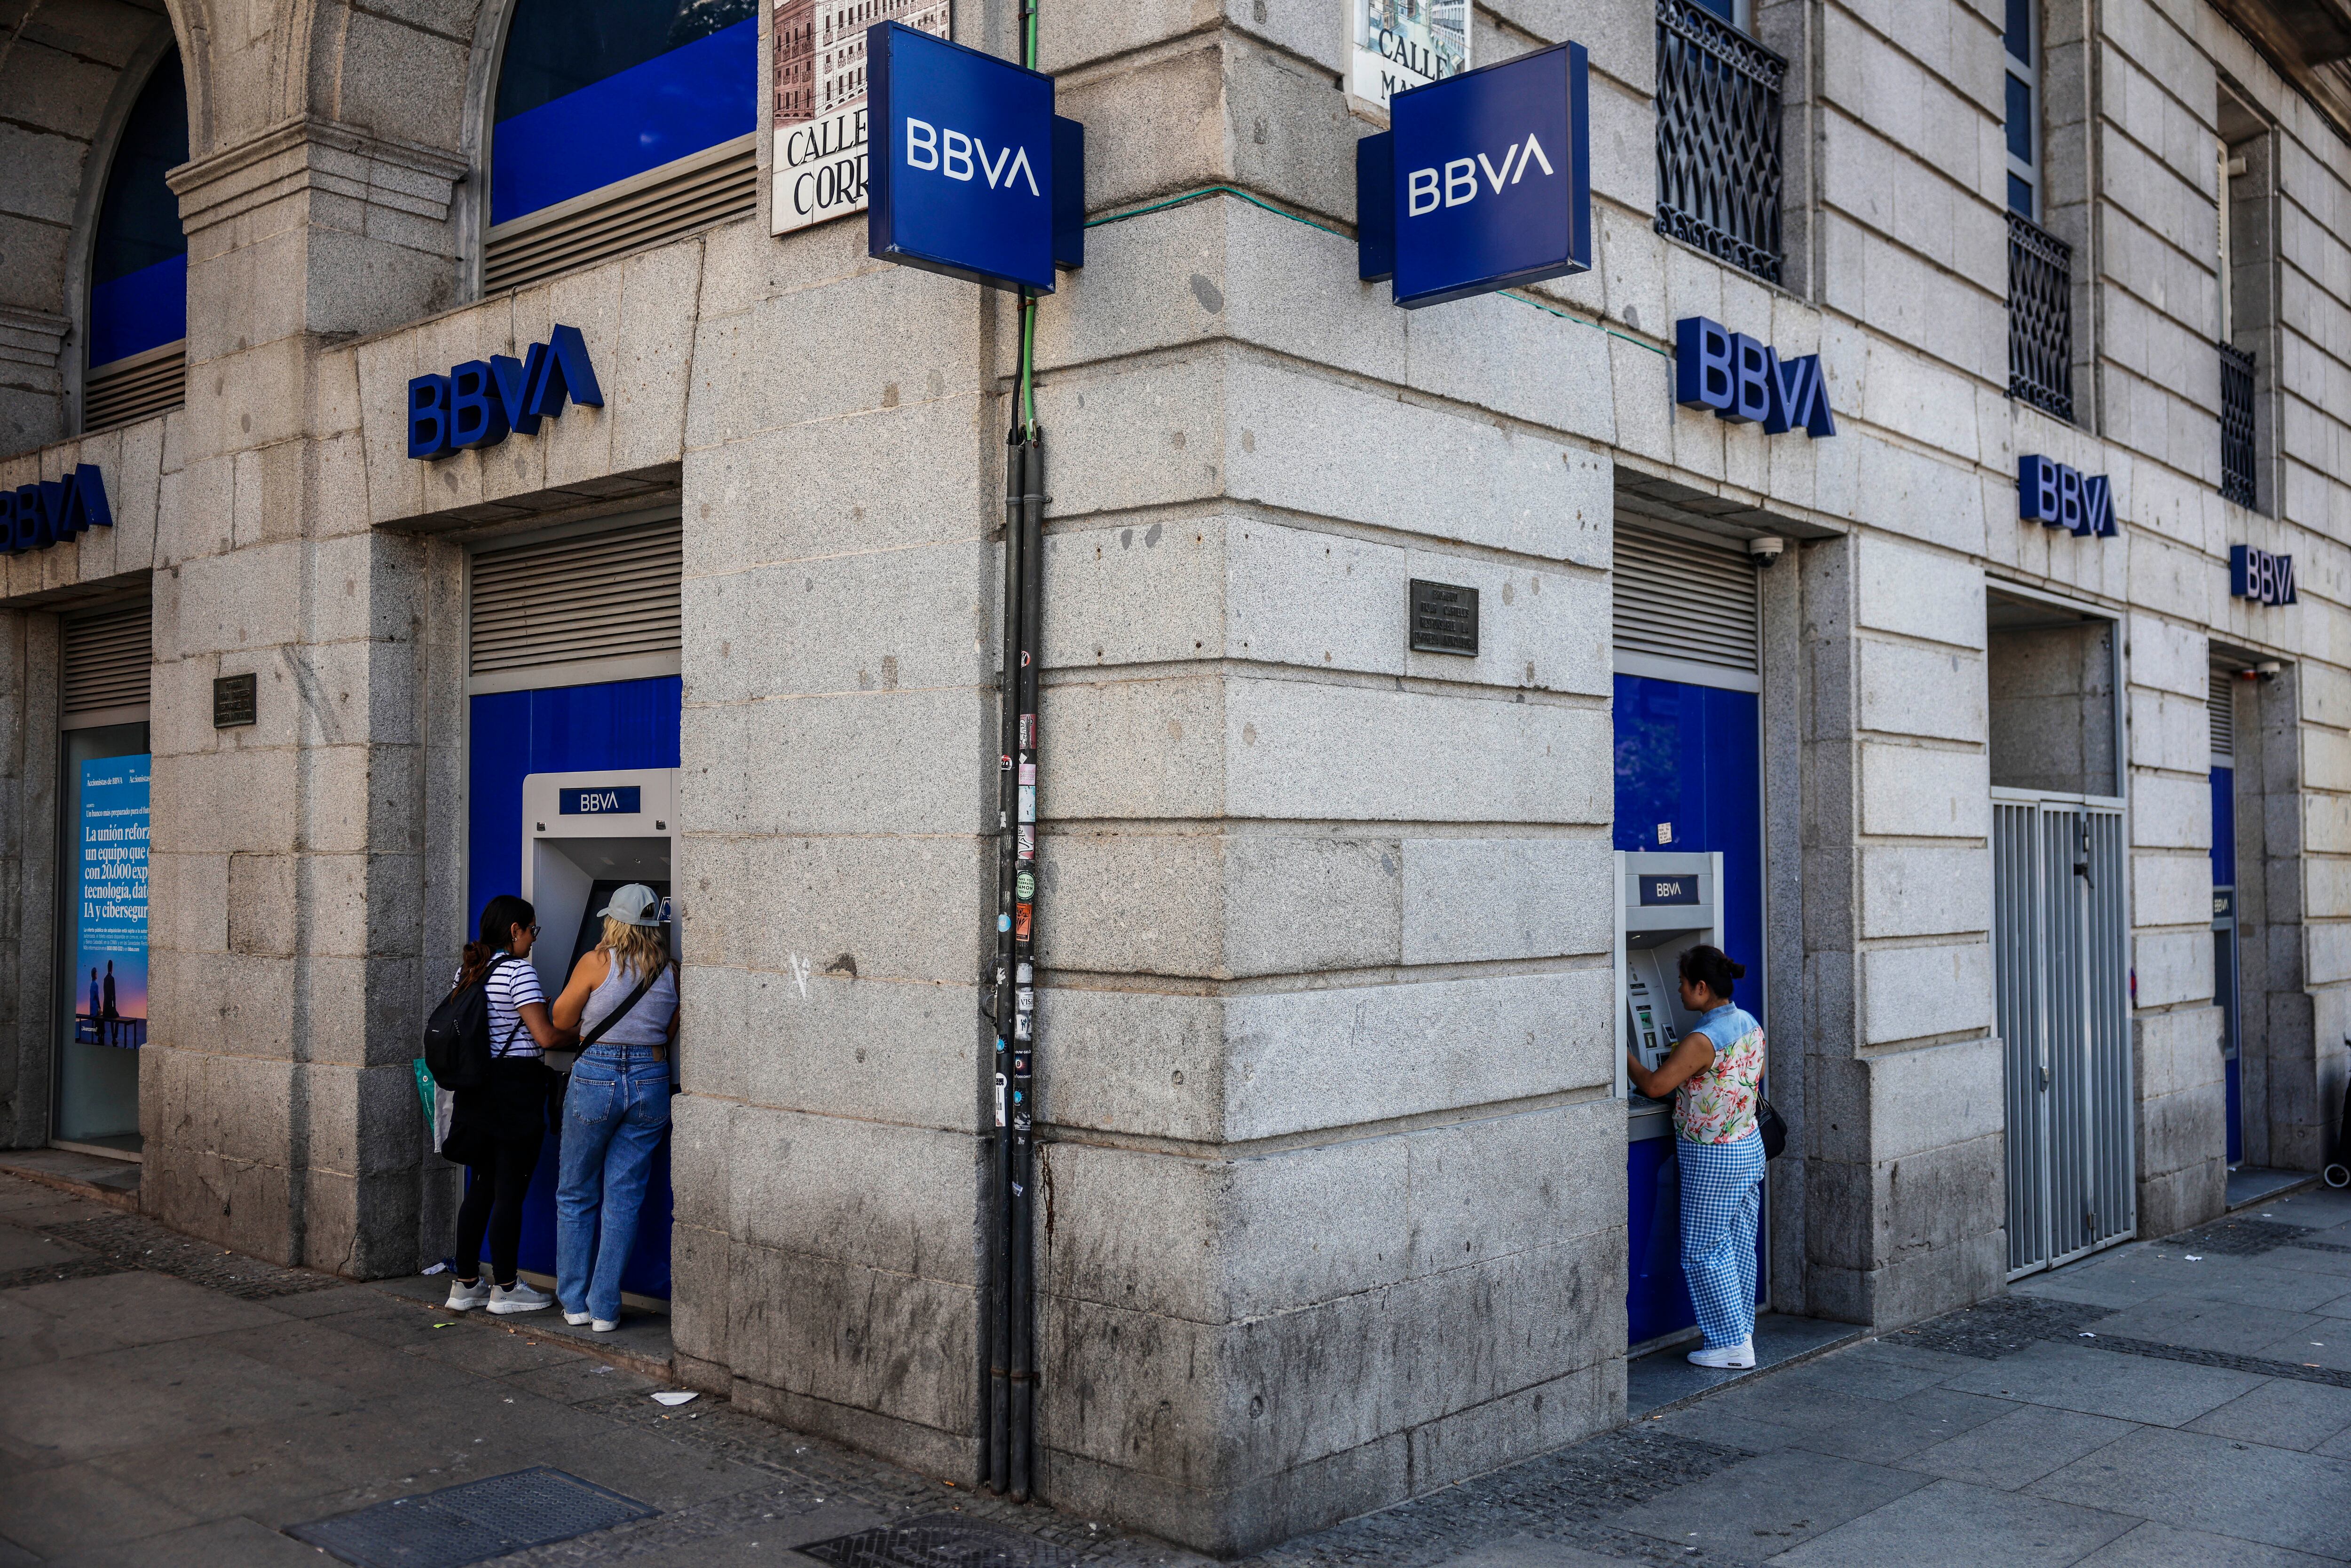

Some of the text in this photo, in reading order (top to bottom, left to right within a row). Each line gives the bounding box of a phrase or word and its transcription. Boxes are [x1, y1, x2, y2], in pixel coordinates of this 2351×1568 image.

[1378, 29, 1447, 81] CALLE
[788, 107, 868, 167] CALLE
[907, 117, 1040, 197] BBVA
[1409, 133, 1554, 217] BBVA
[1677, 316, 1836, 438] BBVA
[408, 323, 604, 461] BBVA
[2019, 455, 2119, 538] BBVA
[2230, 544, 2297, 607] BBVA
[129, 775, 150, 783] Accionistas
[581, 791, 618, 812] BBVA
[111, 807, 130, 818] preparado
[86, 827, 96, 842] La
[98, 824, 123, 841] unión
[86, 848, 96, 860] un
[98, 843, 128, 864] equipo
[129, 847, 145, 864] que
[85, 867, 100, 880] con
[101, 864, 131, 879] 20.000
[85, 882, 131, 903] tecnología,
[1657, 882, 1681, 897] BBVA
[84, 901, 148, 922] IA y cibersegur
[2214, 898, 2229, 913] BBVA
